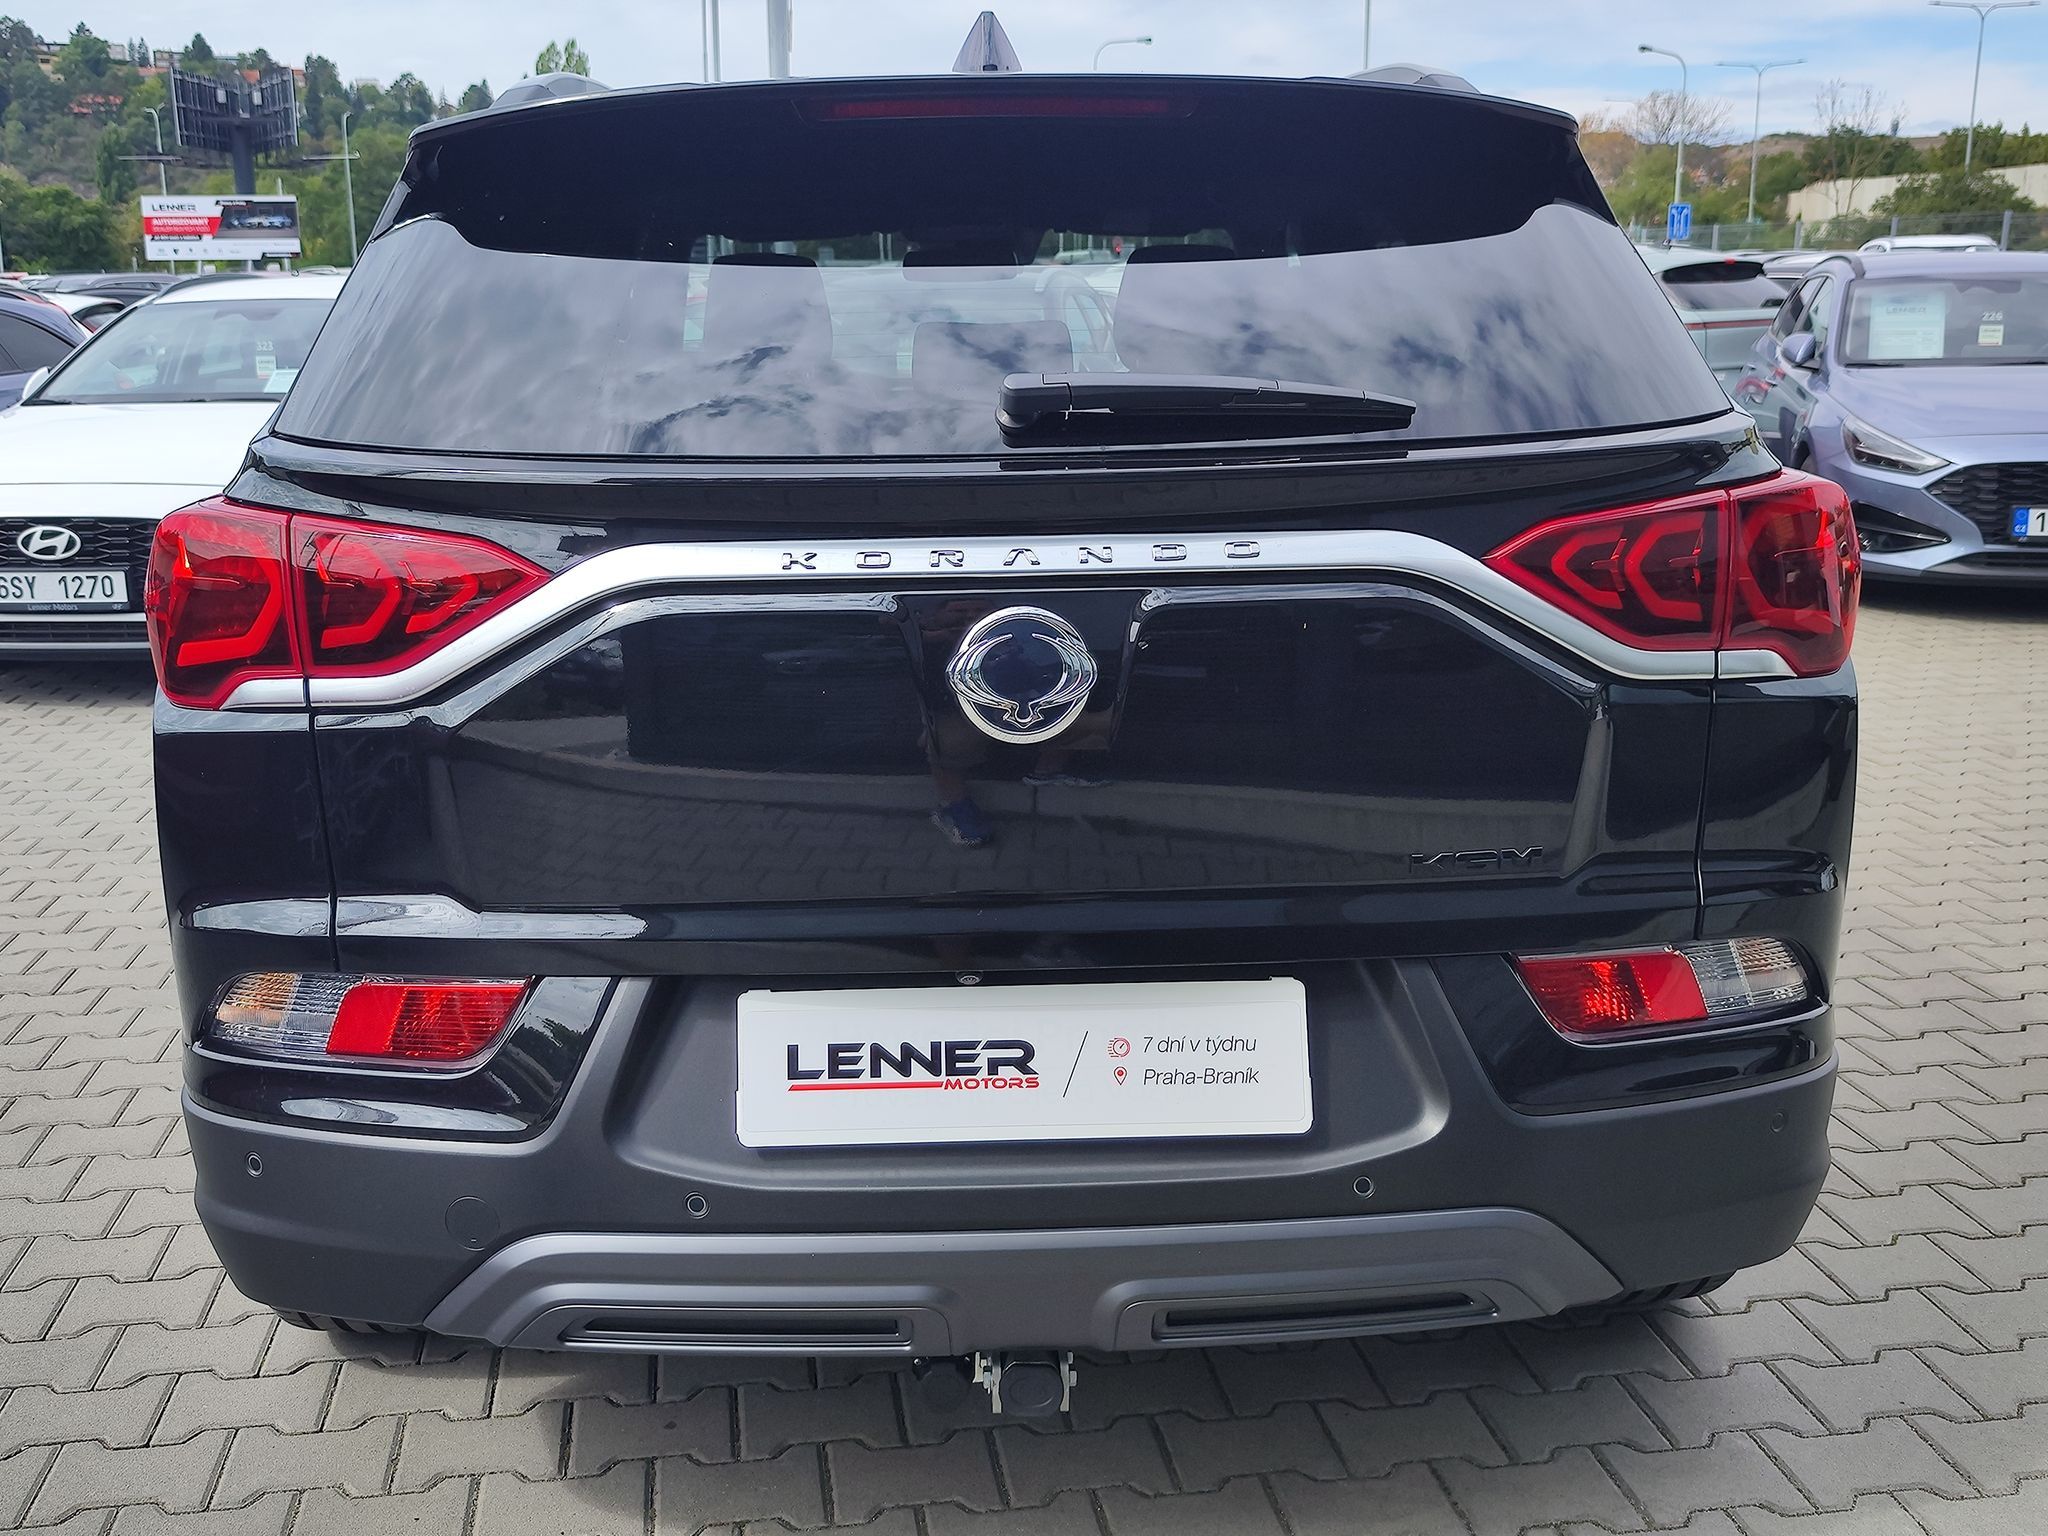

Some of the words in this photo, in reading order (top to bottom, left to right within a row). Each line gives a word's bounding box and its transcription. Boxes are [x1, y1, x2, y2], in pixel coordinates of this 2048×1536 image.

[781, 540, 1261, 571] KORANDO
[58, 575, 114, 599] 1270
[1143, 1036, 1154, 1053] 7
[1157, 1035, 1186, 1053] dní
[1190, 1039, 1201, 1052] v
[1206, 1035, 1257, 1056] týdnu
[786, 1039, 1039, 1080] LENNER
[943, 1076, 1040, 1091] MOTORS
[1143, 1066, 1260, 1086] Praha-Braník
